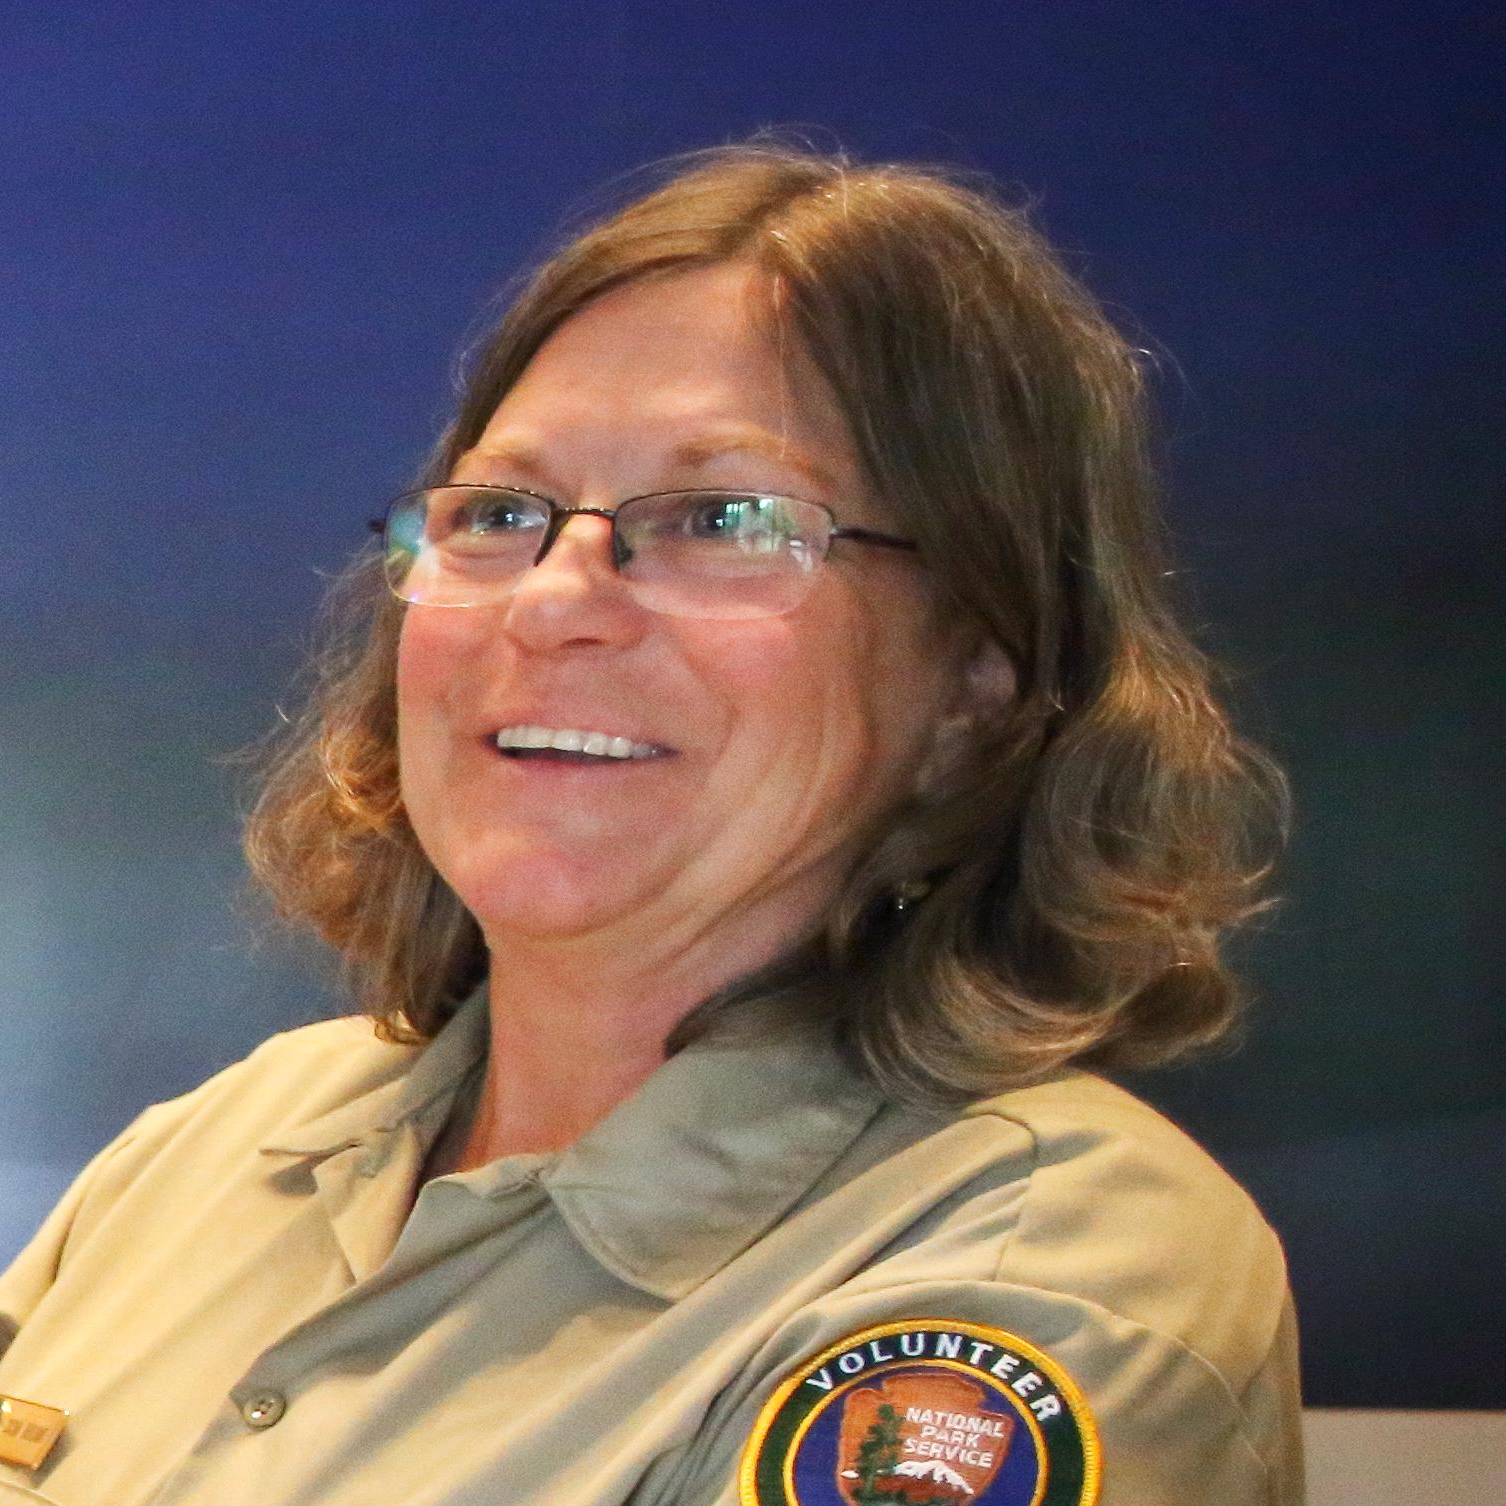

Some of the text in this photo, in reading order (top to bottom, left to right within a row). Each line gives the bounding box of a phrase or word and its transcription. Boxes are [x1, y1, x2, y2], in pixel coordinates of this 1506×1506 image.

[806, 1333, 1061, 1421] VOLUNTEER
[905, 1407, 1005, 1438] NATIONAL
[920, 1426, 981, 1448] PARK
[903, 1438, 993, 1468] SERVICE
